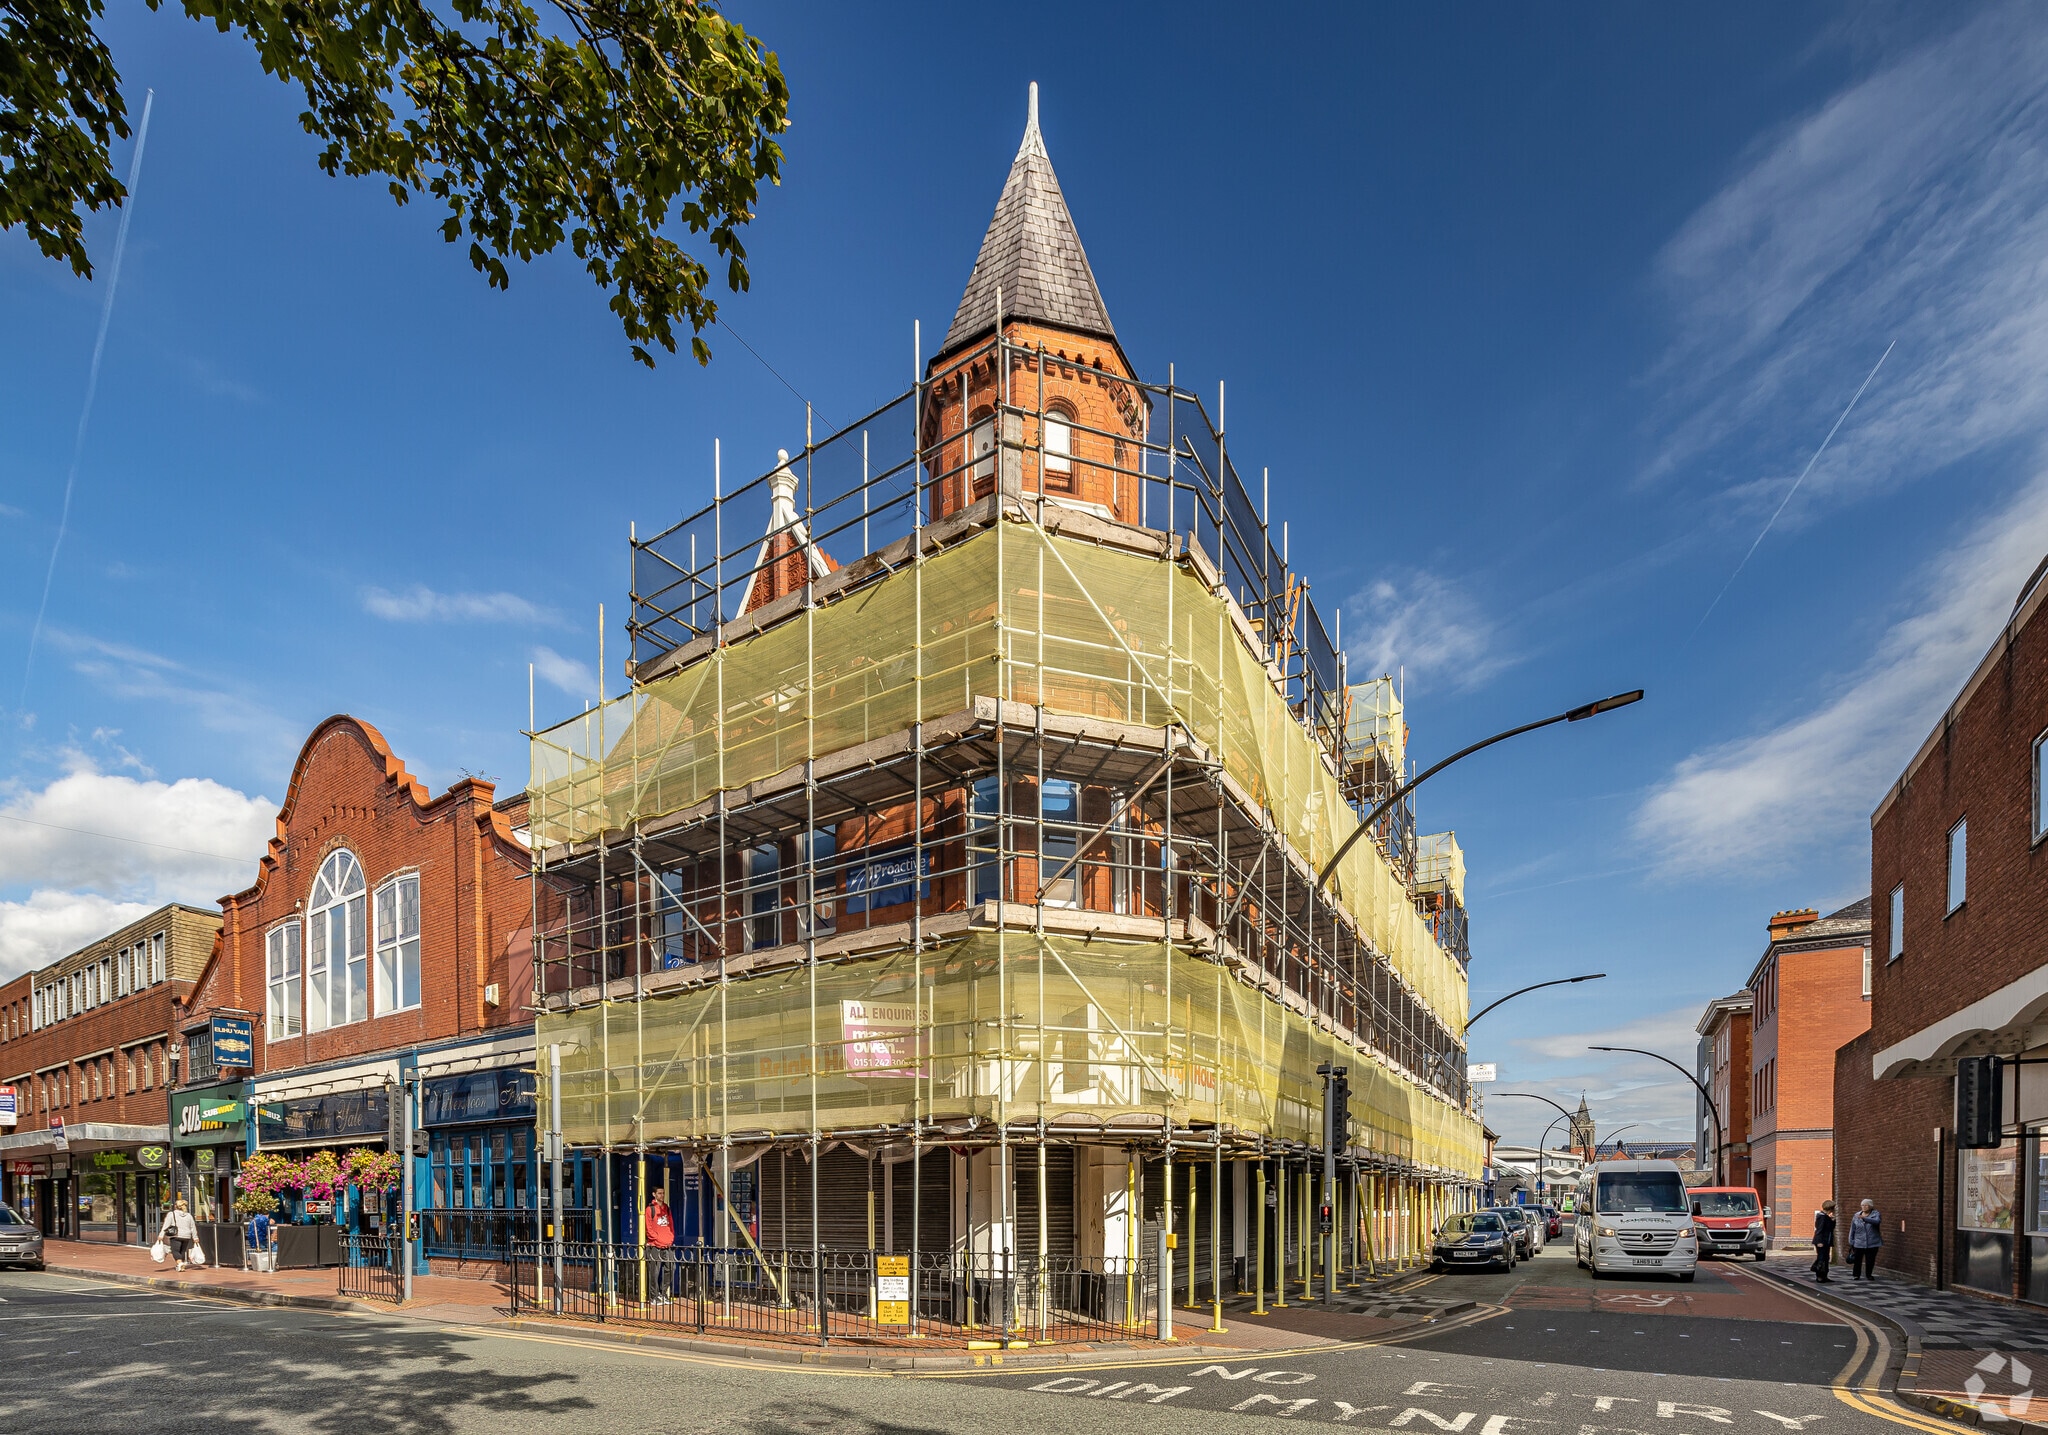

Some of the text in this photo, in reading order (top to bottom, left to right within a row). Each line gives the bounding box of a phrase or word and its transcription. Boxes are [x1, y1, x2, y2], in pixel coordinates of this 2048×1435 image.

[874, 857, 927, 879] Proactive
[849, 1006, 929, 1021] ALL ENQUIRIS
[201, 1103, 237, 1119] SUBWAY
[16, 1163, 32, 1173] illy
[1026, 1376, 1195, 1403] DIM
[1187, 1365, 1828, 1430] NO ETRY
